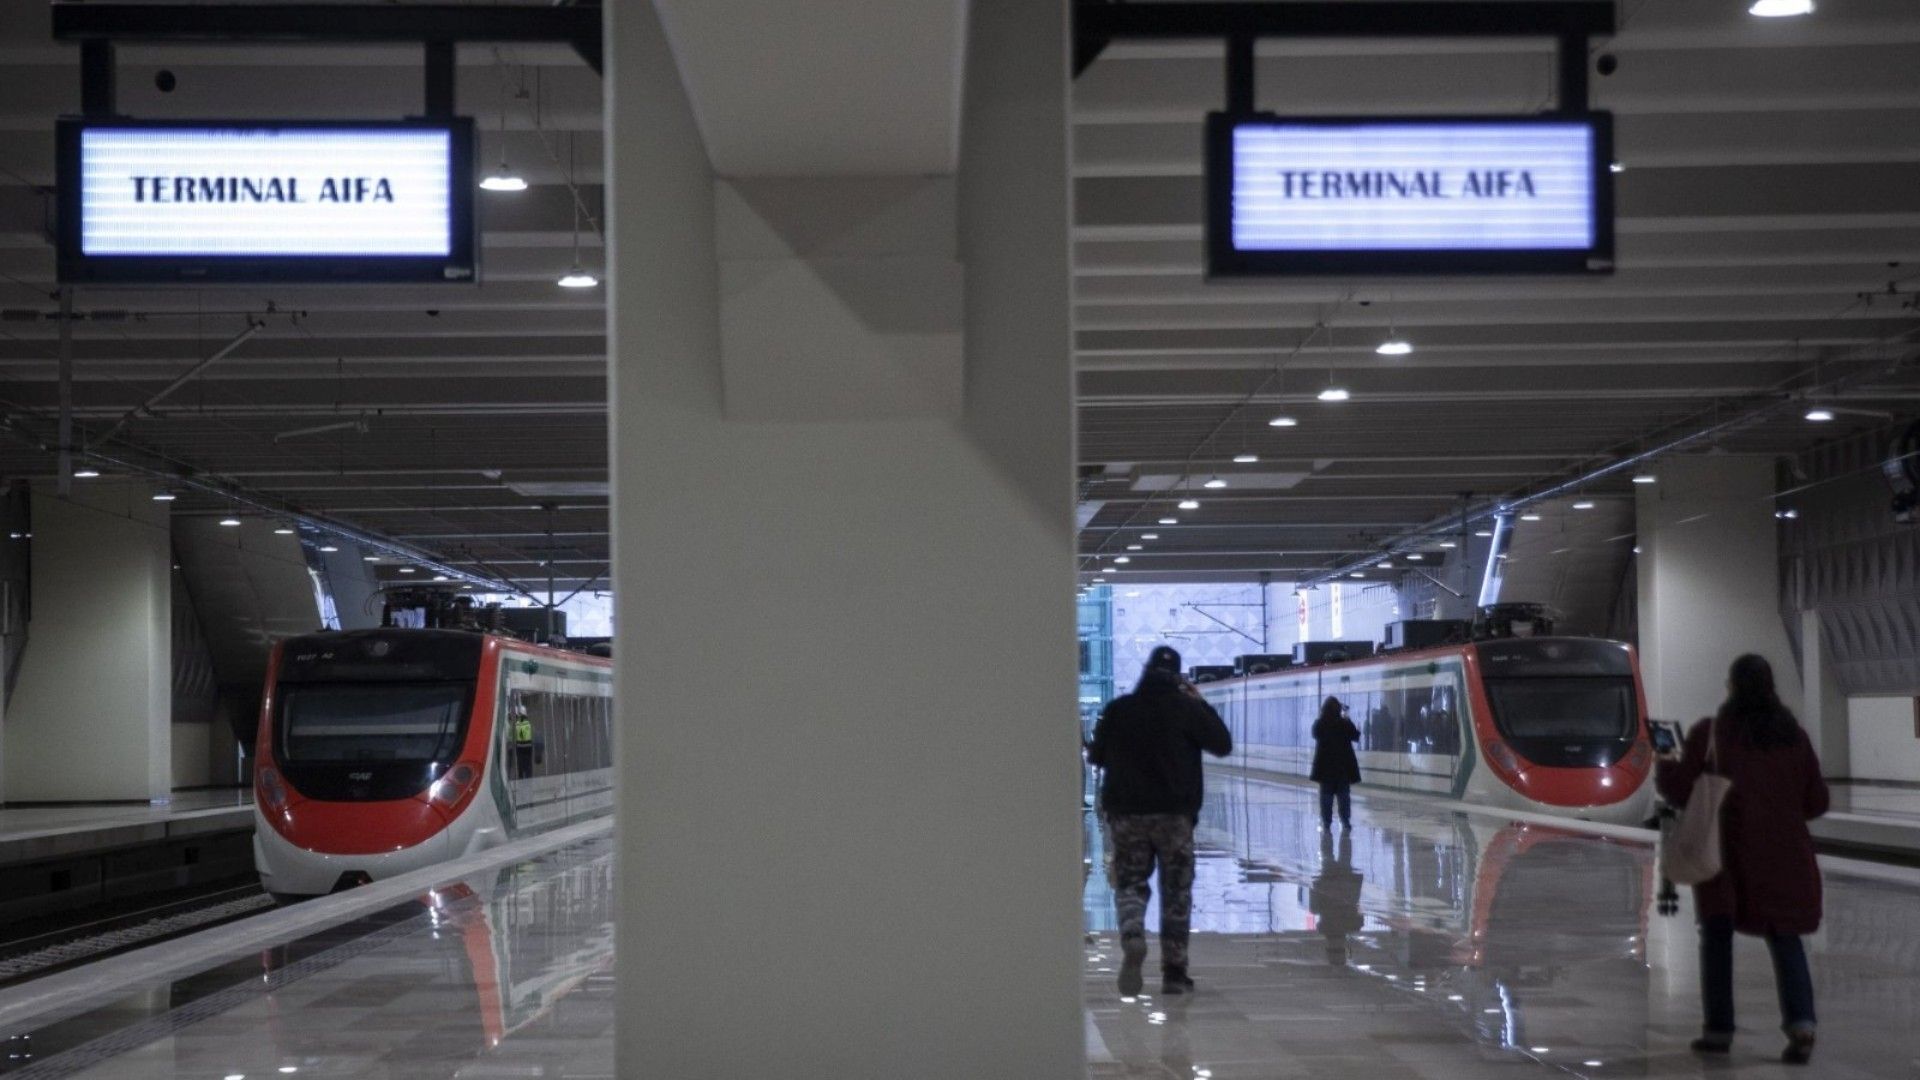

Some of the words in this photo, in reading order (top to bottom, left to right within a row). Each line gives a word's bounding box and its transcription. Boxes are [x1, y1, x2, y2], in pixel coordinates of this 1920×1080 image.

[131, 176, 306, 203] TERMINAL
[319, 176, 394, 203] AIFA
[1280, 170, 1450, 198] TERMINAL
[1463, 170, 1536, 198] AIFA
